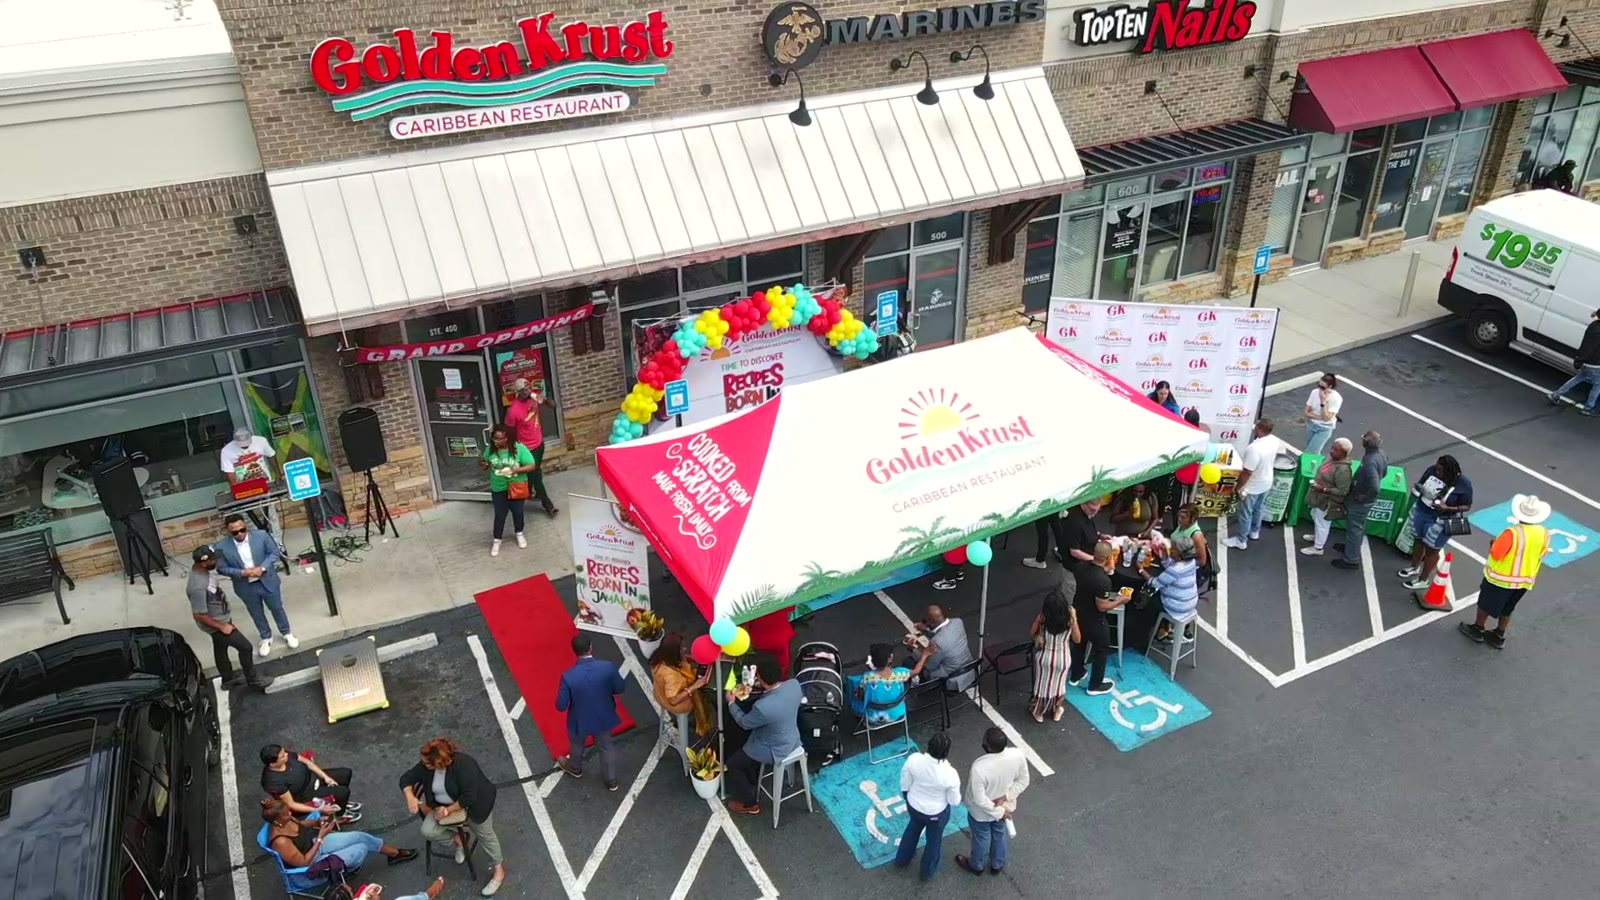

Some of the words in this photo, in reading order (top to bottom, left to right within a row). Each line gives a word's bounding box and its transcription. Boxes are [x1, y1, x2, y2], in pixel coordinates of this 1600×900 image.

[828, 1, 1045, 45] MARINES
[1142, 0, 1257, 52] Nails
[395, 112, 506, 136] CARIBBEAN
[511, 95, 623, 124] RESTAURANT
[1399, 158, 1411, 168] SEA
[1118, 185, 1139, 197] 600
[931, 231, 947, 241] 500
[1024, 272, 1051, 284] RINES
[1470, 267, 1484, 278] Truck
[1484, 271, 1500, 283] Share
[1500, 278, 1512, 289] 24/7
[918, 300, 952, 312] MARINES
[1107, 304, 1126, 316] GK
[1197, 310, 1217, 322] GK
[366, 341, 466, 362] GRAND
[476, 308, 588, 348] OPENING
[429, 326, 443, 337] STE.
[445, 324, 458, 334] 400
[1059, 326, 1078, 337] GK
[1148, 331, 1167, 343] GK
[1239, 336, 1258, 347] GK
[721, 361, 739, 372] TIME
[739, 359, 749, 369] TO
[750, 351, 784, 366] DISCOVER
[1100, 353, 1119, 365] GK
[1189, 358, 1209, 369] GK
[723, 362, 784, 397] RECIPES
[1141, 378, 1159, 390] GK
[1229, 384, 1249, 395] GK
[725, 389, 764, 413] BORN
[1220, 429, 1239, 440] GK
[687, 432, 737, 483] COOKED
[725, 479, 753, 508] FROM
[892, 479, 969, 513] CARIBBEAN
[970, 455, 1048, 488] RESTAURANT
[672, 459, 734, 523] SCRATCH
[652, 470, 677, 494] MADE
[670, 489, 696, 518] FRESH
[688, 511, 714, 536] DAILY
[586, 558, 640, 585] RECIPES
[588, 577, 622, 595] BORN
[624, 582, 637, 598] IN
